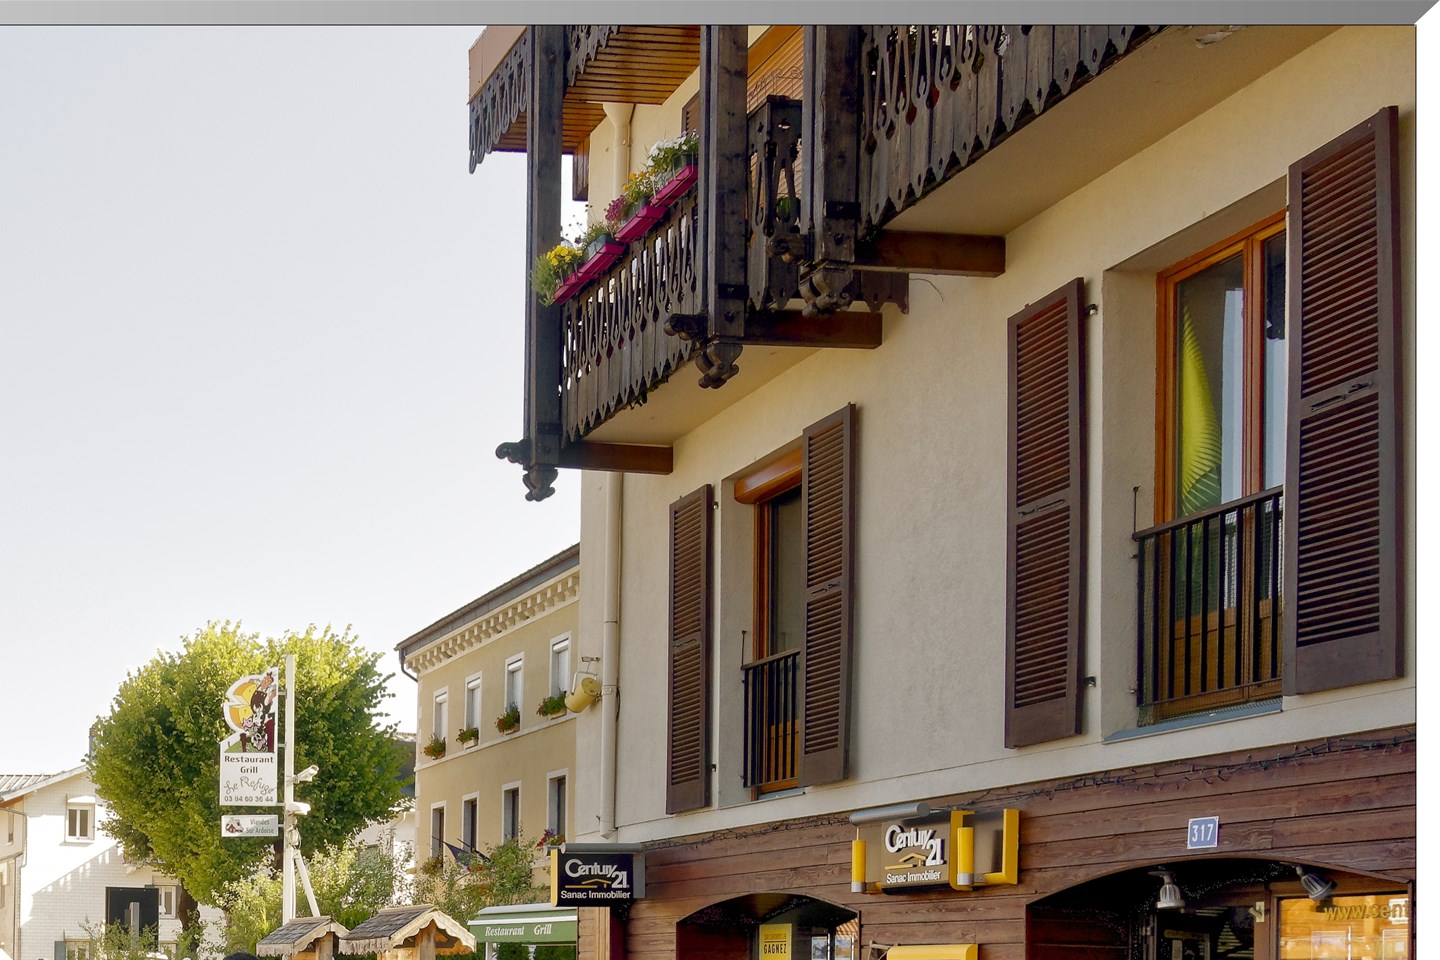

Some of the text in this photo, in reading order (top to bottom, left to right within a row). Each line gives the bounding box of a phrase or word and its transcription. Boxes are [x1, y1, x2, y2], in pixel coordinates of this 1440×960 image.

[224, 755, 274, 763] Restaurant
[240, 766, 258, 774] Grill
[224, 776, 275, 796] Le Refuge
[885, 824, 933, 853] Century
[1191, 823, 1214, 842] 317
[565, 858, 630, 889] Century 21
[886, 870, 941, 884] Sanac Immobilier
[561, 890, 631, 899] Sanac Immobilier
[485, 924, 552, 937] Restaurant Grill
[763, 943, 787, 954] GAGNEZ
